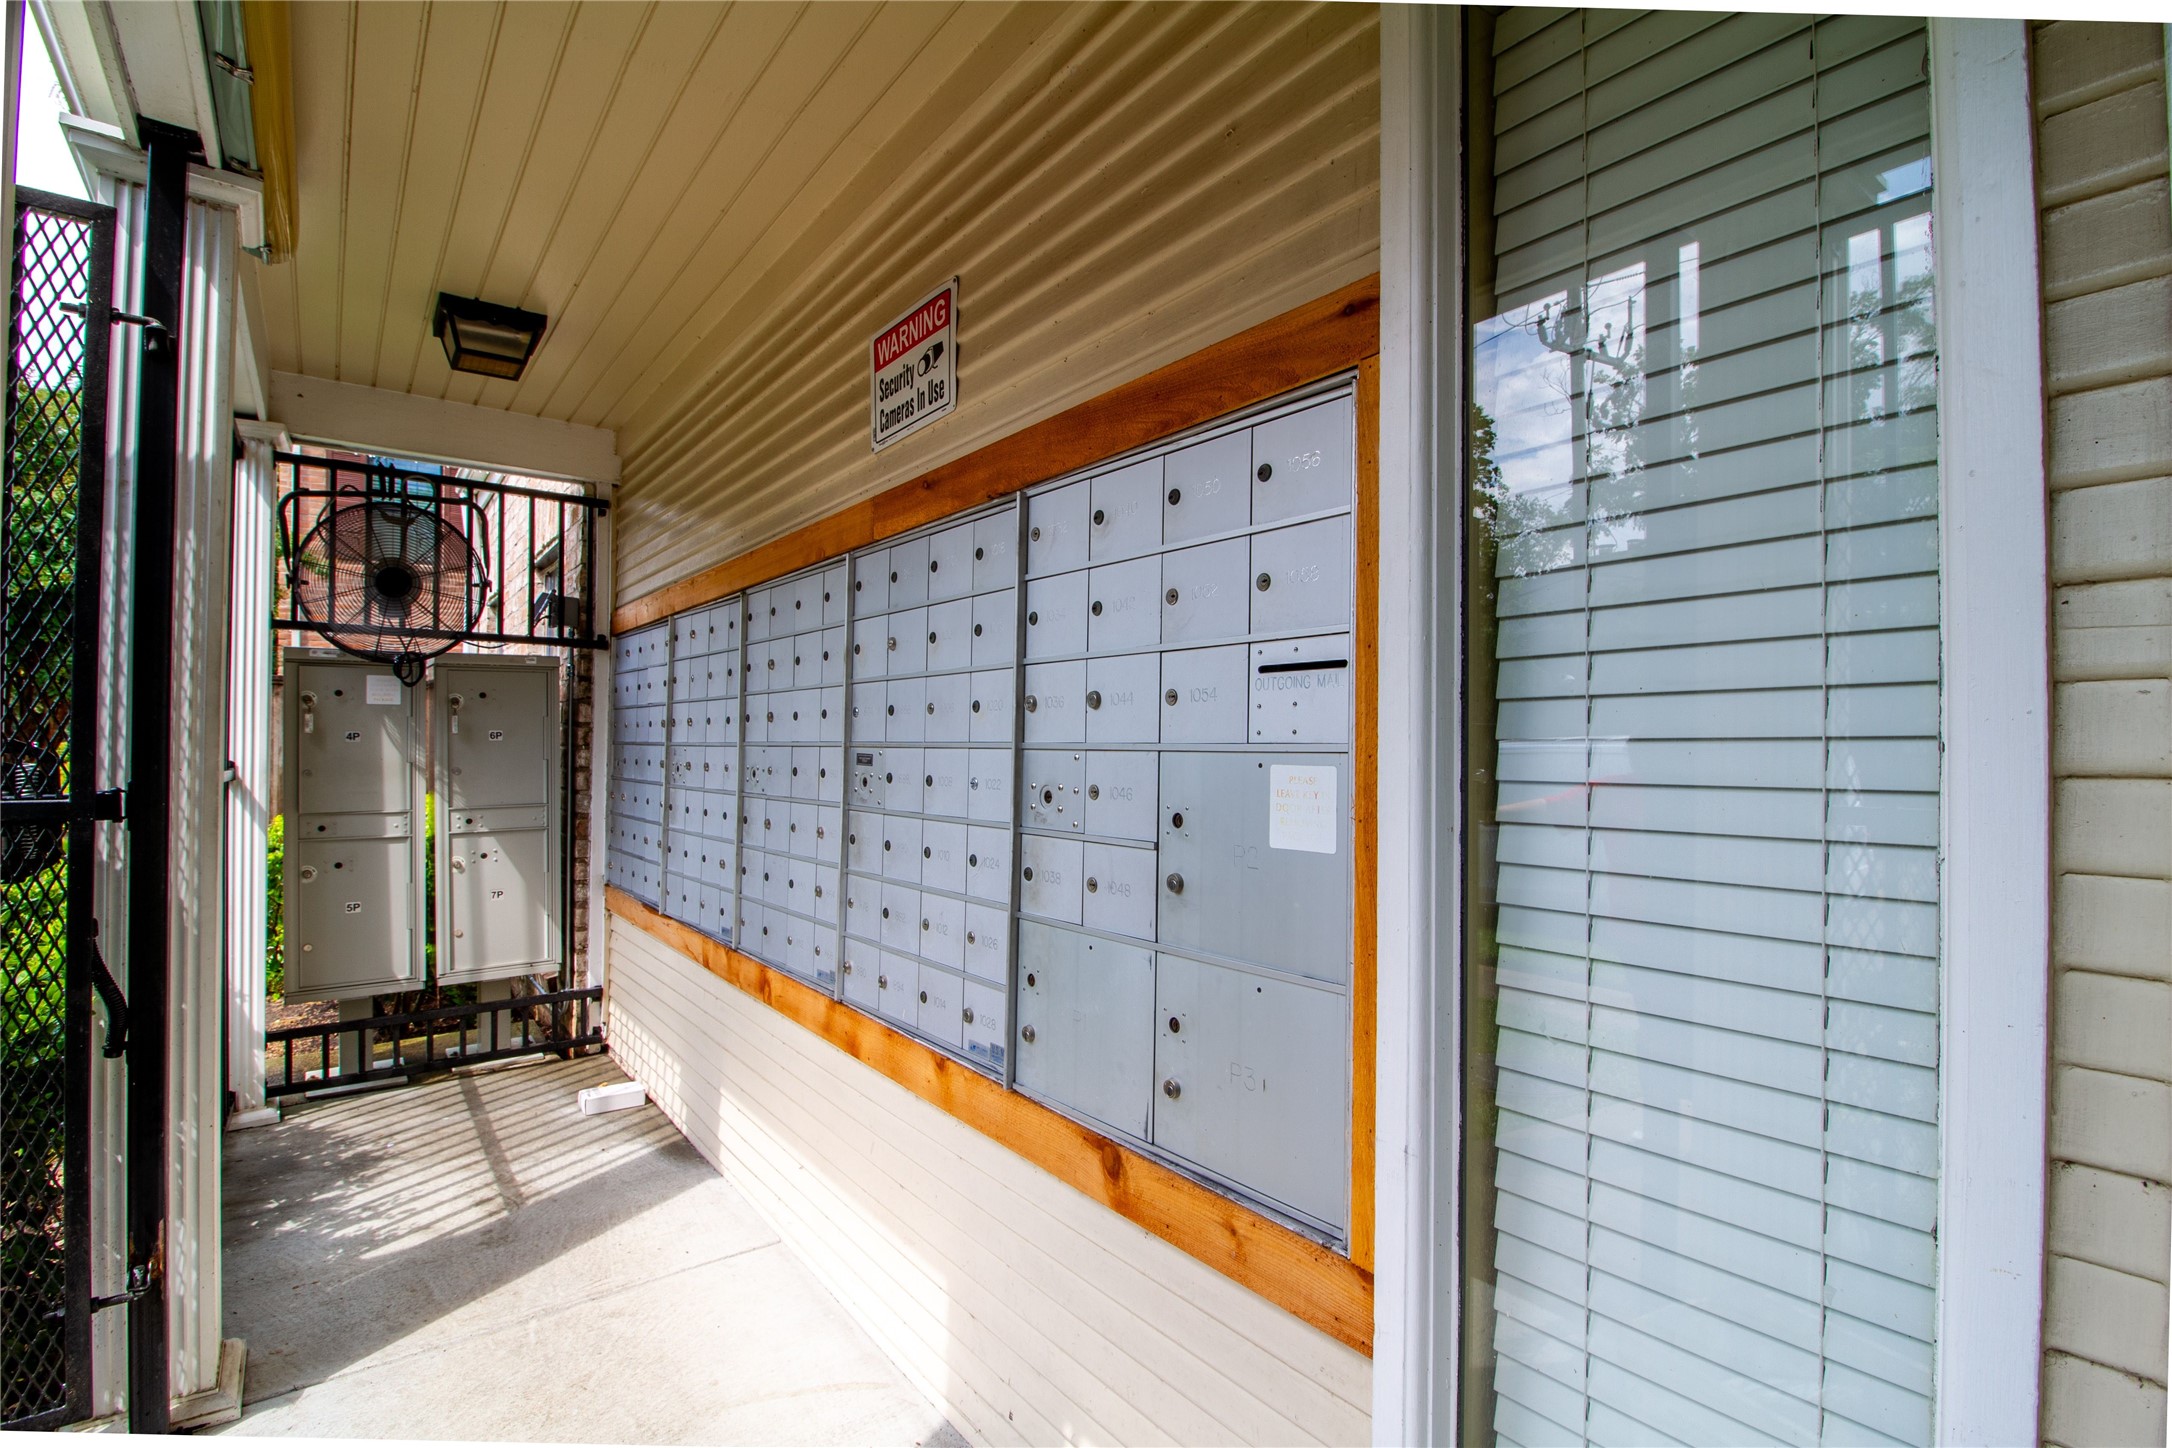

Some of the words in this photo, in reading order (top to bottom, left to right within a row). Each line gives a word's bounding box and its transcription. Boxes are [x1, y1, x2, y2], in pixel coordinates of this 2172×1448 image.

[878, 299, 946, 365] WARNING
[879, 363, 915, 402] Security
[880, 399, 914, 433] Cameras
[917, 387, 925, 412] In
[928, 379, 945, 405] Use
[1287, 450, 1321, 472] 1056
[1112, 594, 1136, 614] 1042
[1254, 675, 1311, 691] OUTGOING
[1317, 673, 1344, 688] MAIL
[1045, 696, 1064, 709] 1036
[1110, 691, 1134, 706] 1044
[1190, 687, 1217, 704] 1054
[346, 732, 360, 741] 4P
[490, 732, 502, 740] 6P
[985, 778, 1001, 790] 1022
[1109, 786, 1133, 802] 1046
[983, 856, 1000, 870] 1024
[1233, 844, 1259, 870] P2
[1042, 869, 1061, 885] 1038
[491, 891, 503, 899] 7P
[1108, 880, 1131, 897] 1048
[346, 903, 360, 912] 5P
[936, 922, 948, 935] 1012
[981, 936, 998, 950] 1026
[980, 1014, 996, 1031] 1028
